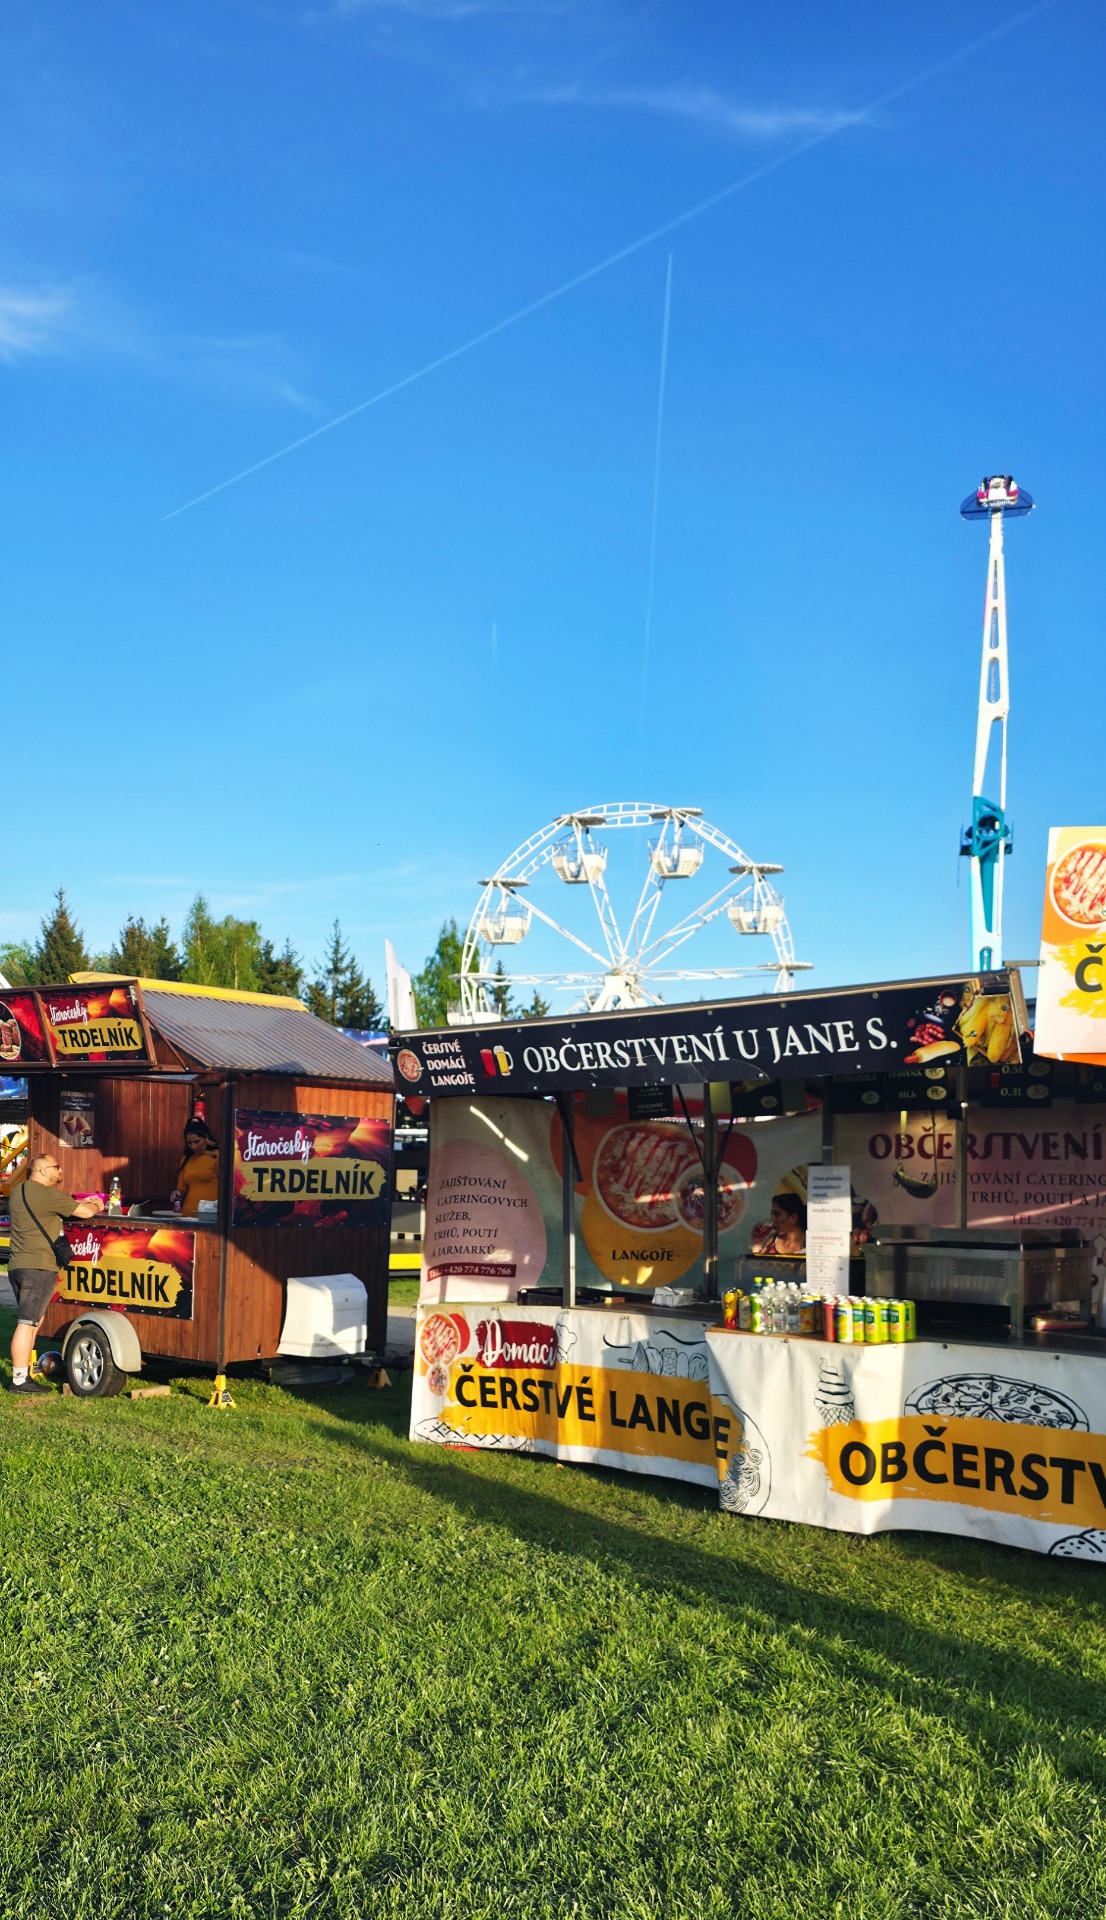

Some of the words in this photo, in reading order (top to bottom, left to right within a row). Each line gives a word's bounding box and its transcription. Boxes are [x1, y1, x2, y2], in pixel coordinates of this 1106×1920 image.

[49, 999, 88, 1025] Staročeský
[58, 1021, 138, 1048] TRDELNÍK
[422, 1039, 462, 1054] ČERSTVÉ
[523, 1025, 730, 1073] OBČERSTVENÍ
[732, 1028, 758, 1060] U
[766, 1019, 859, 1063] JANE
[866, 1017, 898, 1050] S.
[426, 1055, 467, 1070] DOMÁCÍ
[431, 1071, 475, 1086] LANGOŠE
[243, 1130, 314, 1165] Staročeský
[868, 1124, 1102, 1160] OBČERSTVENÍ
[253, 1163, 375, 1195] TRDELNÍK
[440, 1176, 506, 1190] ZAJIŠŤOVÁNÍ
[970, 1189, 1018, 1204] TRHŮ,
[1024, 1190, 1075, 1205] POUTÍ
[435, 1211, 471, 1224] SLUŽEB,
[1045, 1215, 1072, 1226] +420
[1074, 1216, 1094, 1227] 774
[462, 1228, 499, 1238] POUTÍ
[437, 1244, 496, 1258] JARMARKŮ
[611, 1246, 674, 1262] LANGOŠE
[480, 1266, 495, 1274] 776
[497, 1267, 512, 1275] 766
[65, 1265, 170, 1303] TRDELNÍK
[481, 1320, 557, 1367] Domácí
[455, 1364, 596, 1422] ČERSTVÉ
